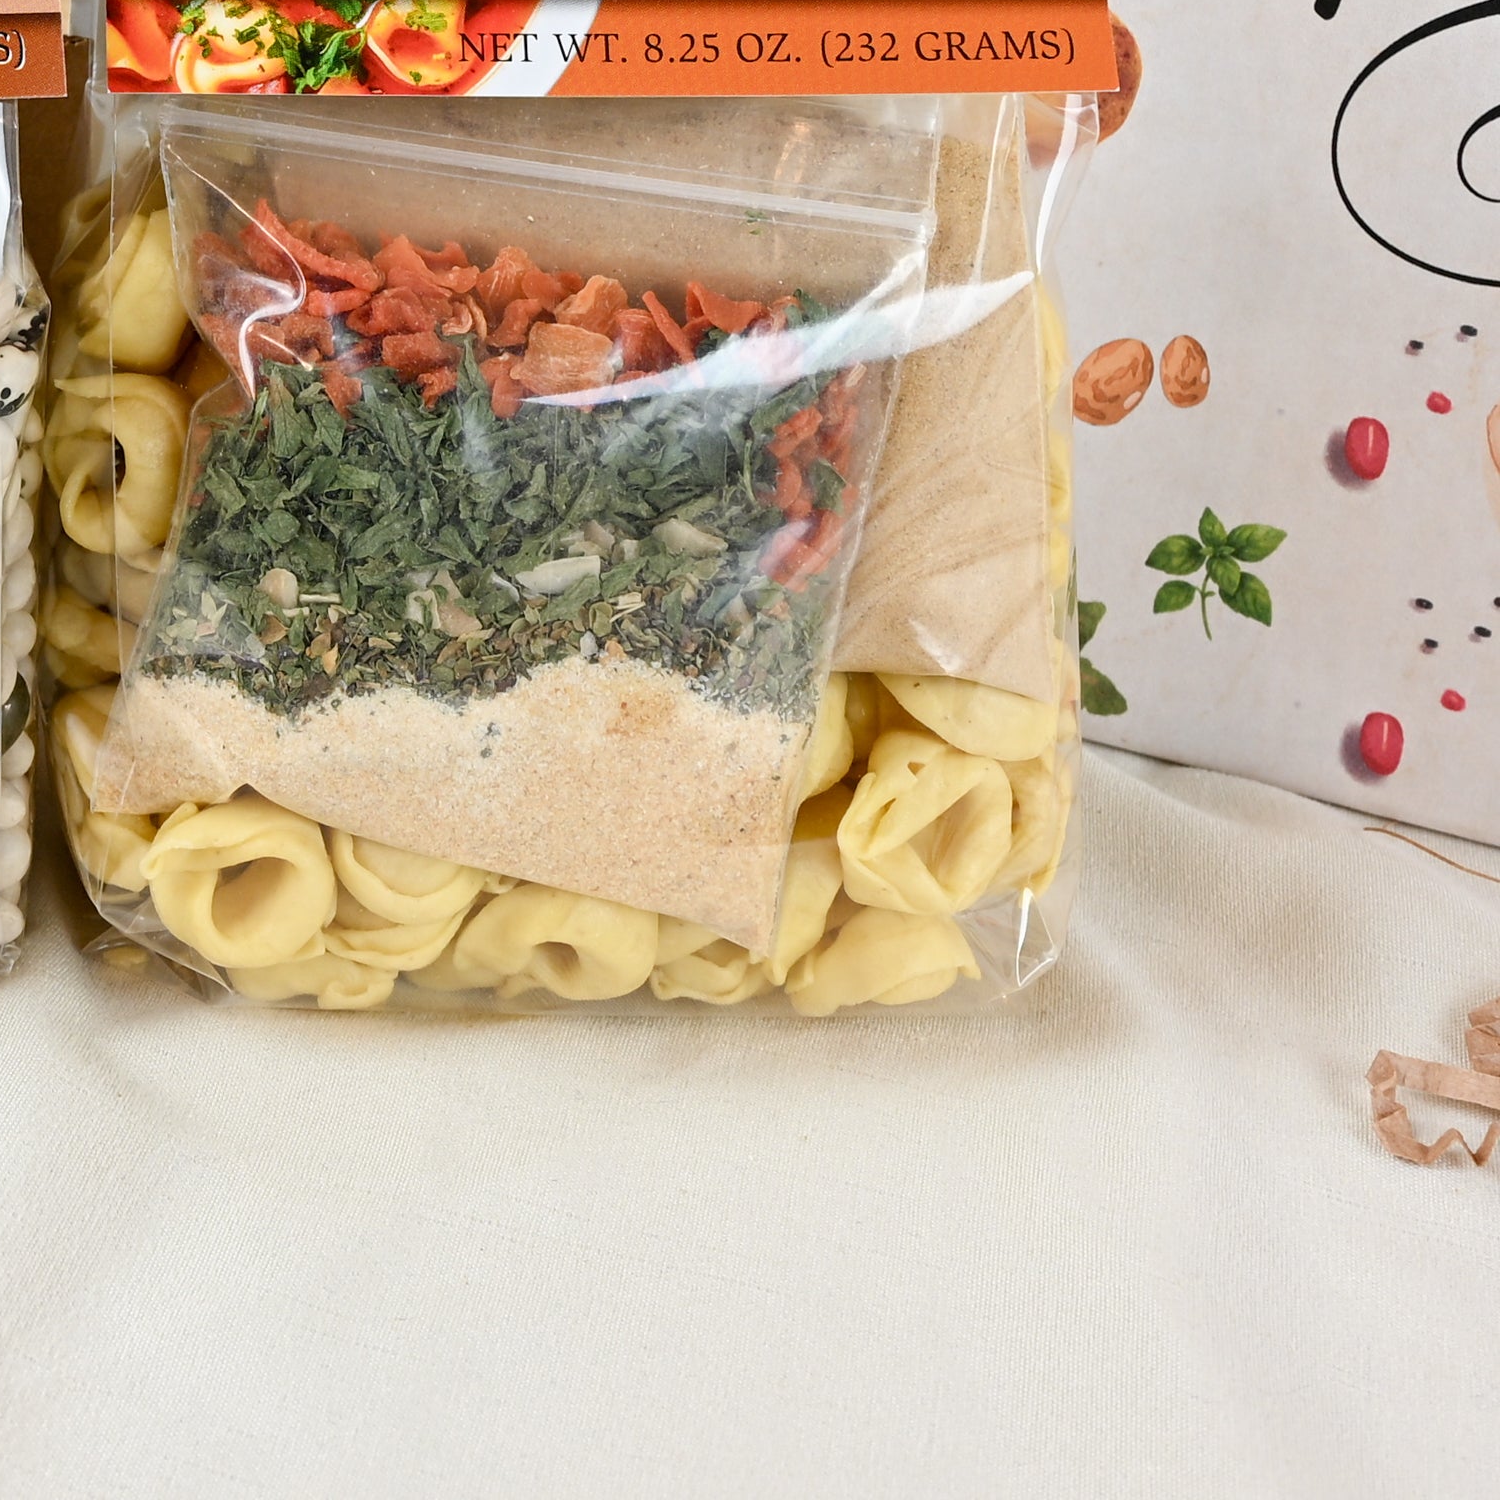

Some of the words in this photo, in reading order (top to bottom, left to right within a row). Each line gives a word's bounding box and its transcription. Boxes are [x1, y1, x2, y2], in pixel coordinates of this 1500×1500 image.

[458, 32, 537, 62] NET
[553, 33, 627, 63] WT.
[644, 32, 720, 63] 8.25
[736, 32, 801, 63] OZ.
[821, 30, 899, 67] (232
[915, 28, 1075, 65] GRAMS)
